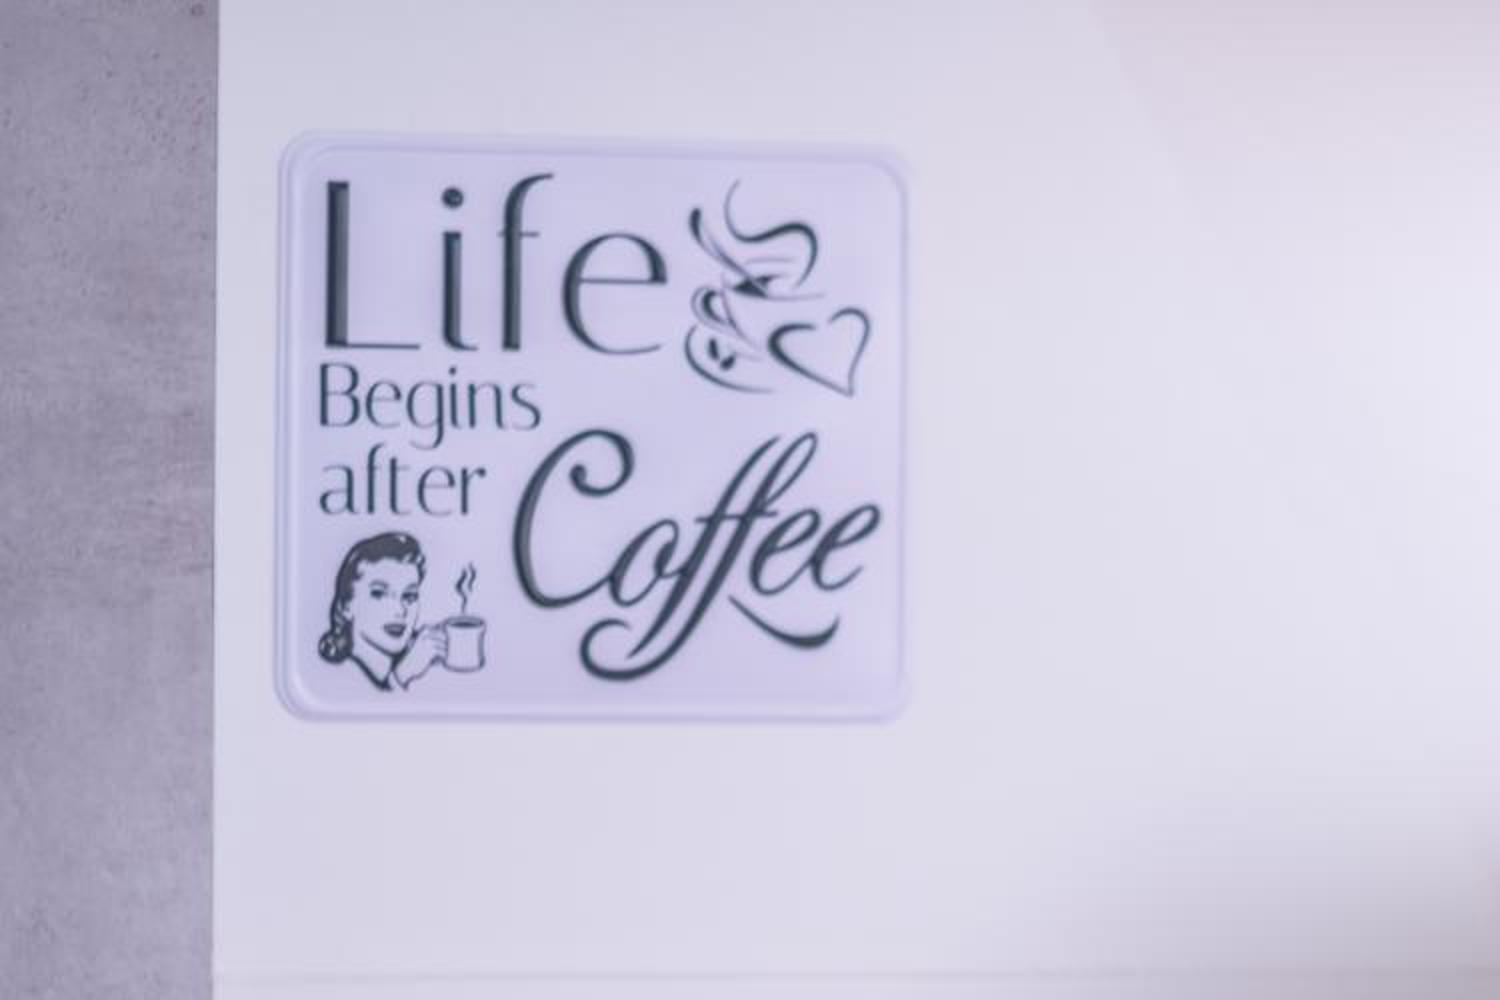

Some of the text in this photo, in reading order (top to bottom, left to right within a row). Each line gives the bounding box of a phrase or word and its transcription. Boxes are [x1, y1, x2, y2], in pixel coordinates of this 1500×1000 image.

[324, 173, 668, 355] Life
[318, 362, 542, 450] Begins
[318, 429, 881, 683] after Coffee
